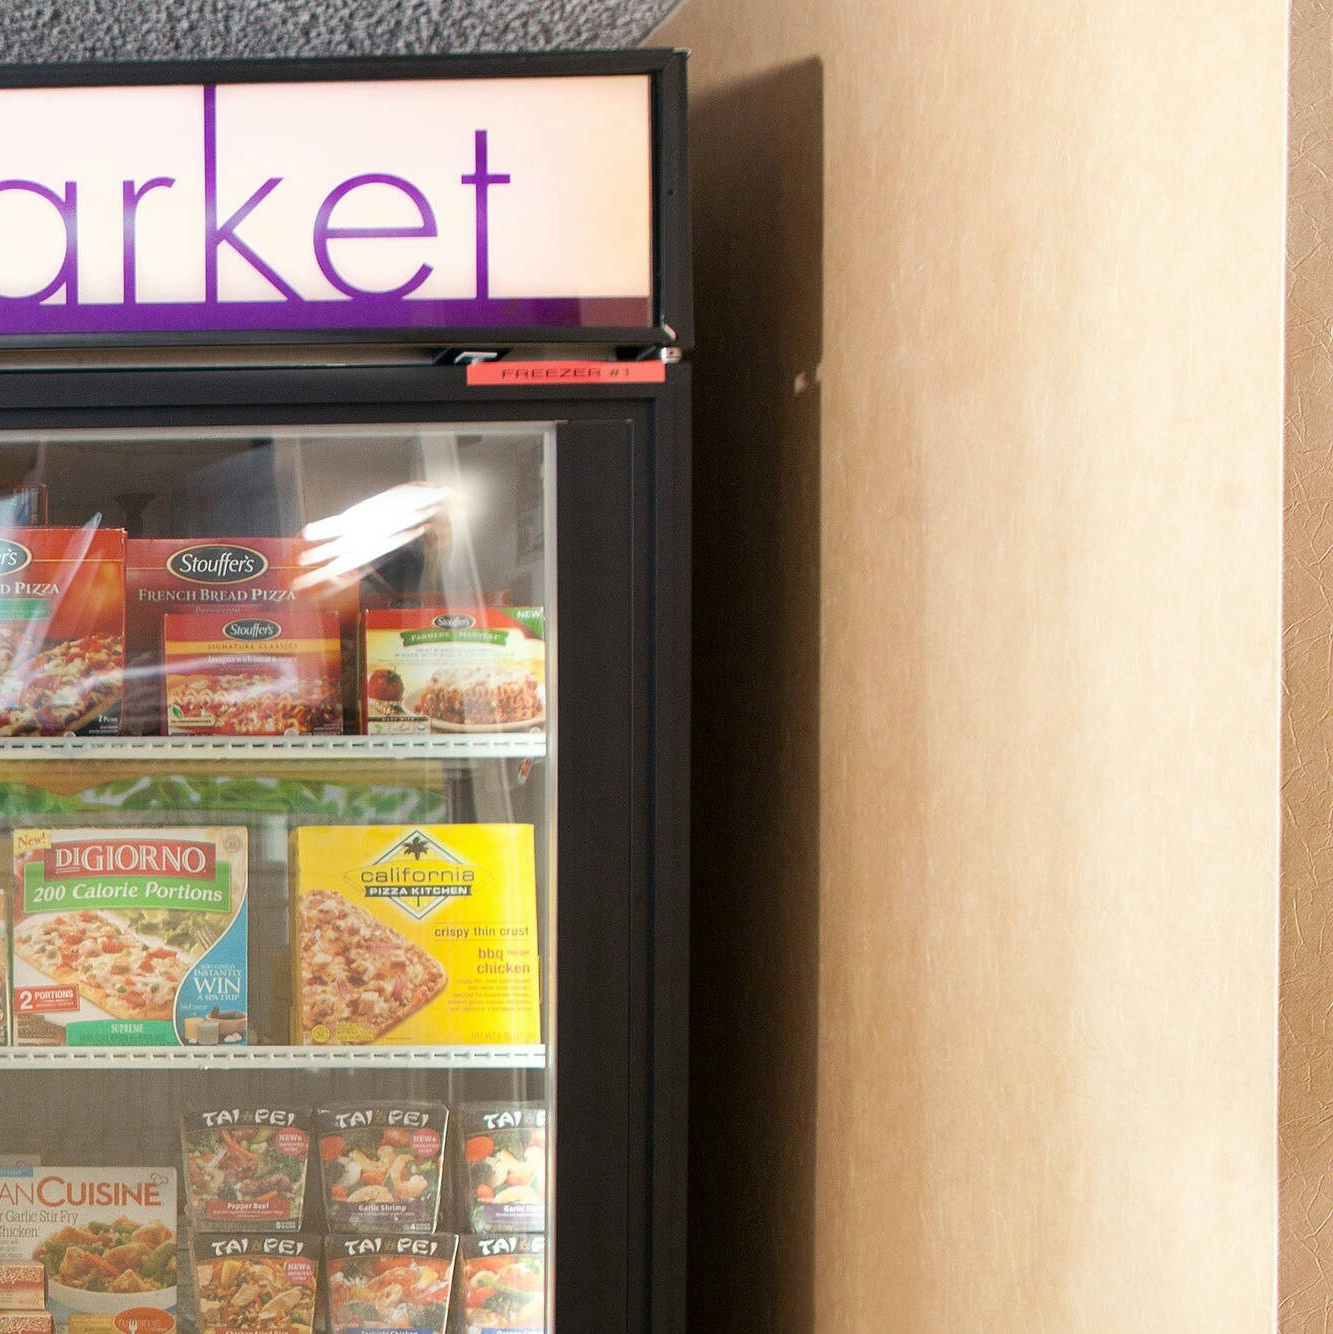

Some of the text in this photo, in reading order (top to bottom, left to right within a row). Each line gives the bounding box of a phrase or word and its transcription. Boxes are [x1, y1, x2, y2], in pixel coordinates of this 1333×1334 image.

[502, 367, 630, 379] FREEZER #1
[179, 554, 255, 577] Stouffer's
[14, 582, 60, 595] PIZZA
[138, 589, 297, 601] FRENCH BREAD PIZZA
[229, 624, 275, 640] Stouffer's
[18, 833, 47, 850] New!
[55, 843, 208, 874] DIGIORNO
[360, 867, 475, 884] california
[33, 881, 223, 903] 200 Calorie Portions
[369, 886, 468, 896] PIZZA KITCHEN
[434, 926, 530, 939] crispy thin crust
[478, 948, 504, 962] bbq
[477, 962, 531, 975] chicken
[194, 977, 241, 994] WIN
[19, 989, 74, 1011] 2 PORTIONS
[202, 1109, 295, 1127] TAI PEI
[335, 1109, 429, 1128] TAI PEI
[36, 1175, 162, 1208] CUISINE
[5, 1210, 37, 1222] Garlic
[39, 1210, 60, 1222] Stir
[61, 1211, 79, 1225] Fry
[211, 1237, 304, 1256] TAI PEI
[344, 1237, 437, 1255] TAI PEI
